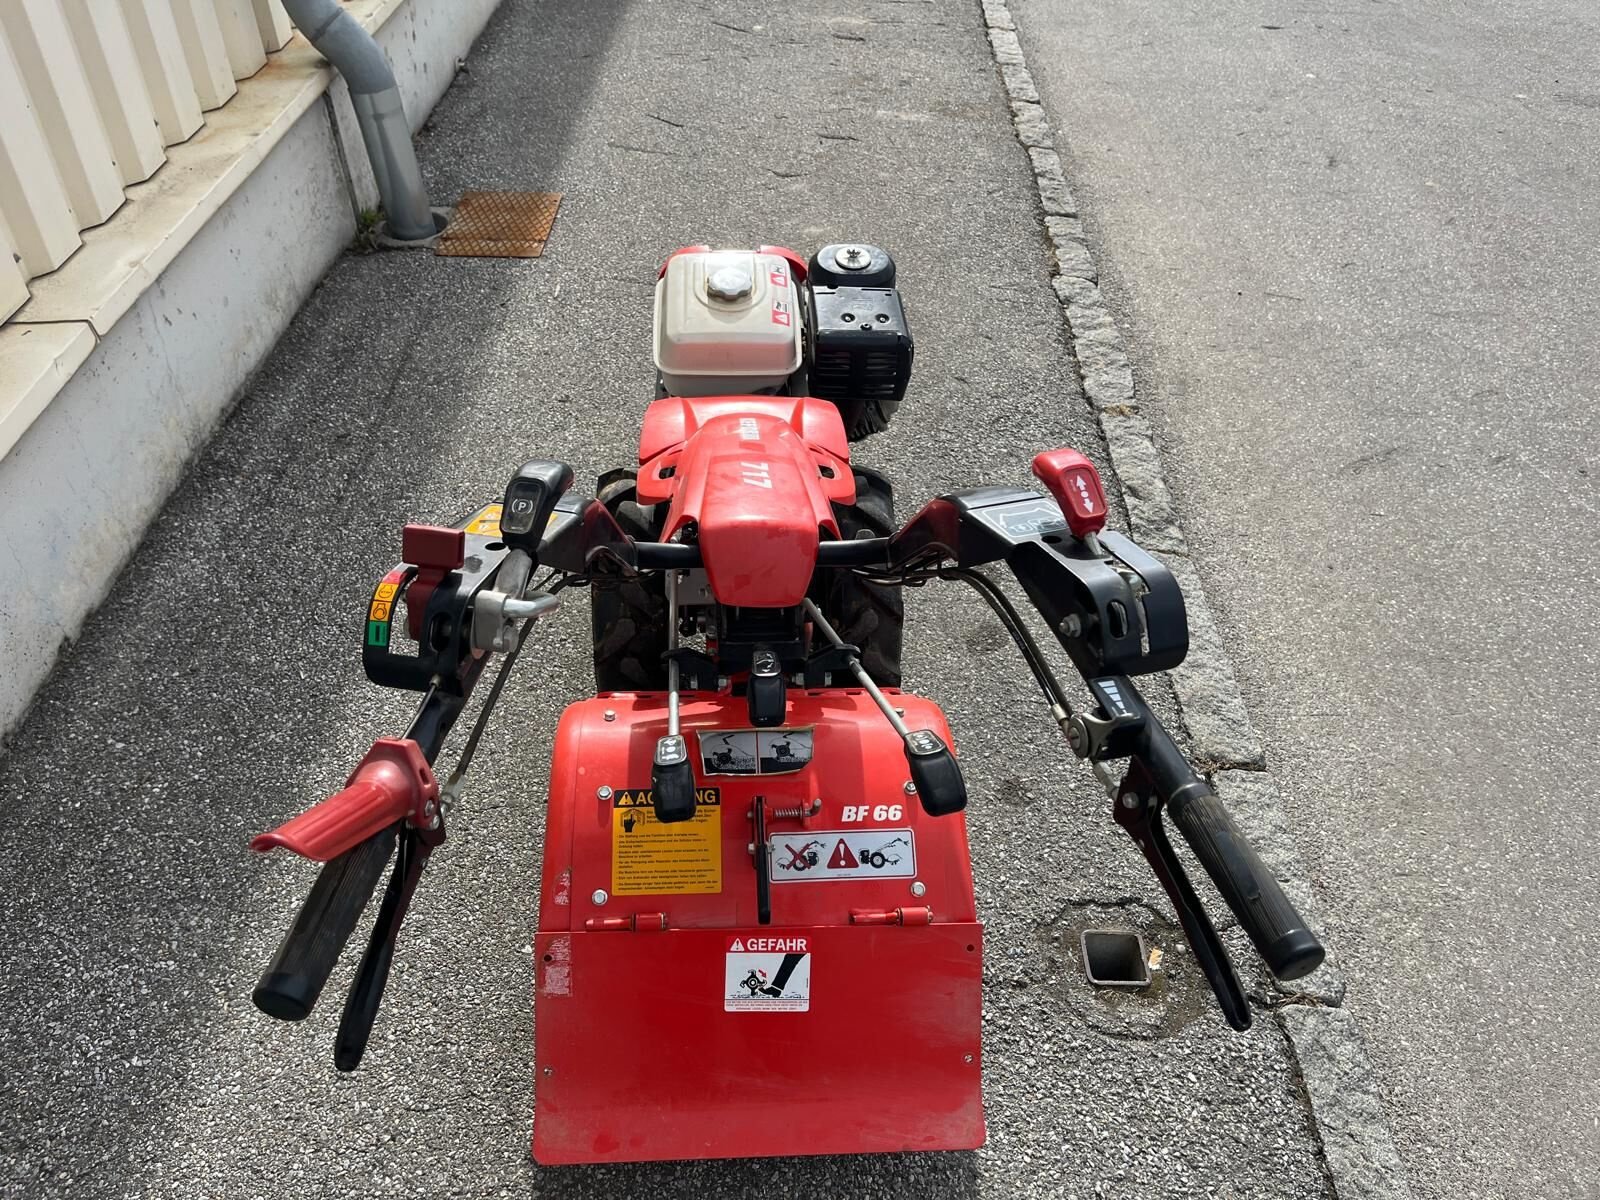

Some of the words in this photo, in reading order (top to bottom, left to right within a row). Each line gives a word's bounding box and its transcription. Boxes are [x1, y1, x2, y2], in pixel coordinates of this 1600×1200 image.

[740, 461, 772, 489] 717
[635, 789, 716, 805] ACNG
[841, 805, 870, 822] BF
[873, 804, 903, 821] 66
[746, 938, 807, 951] GEFAHR
